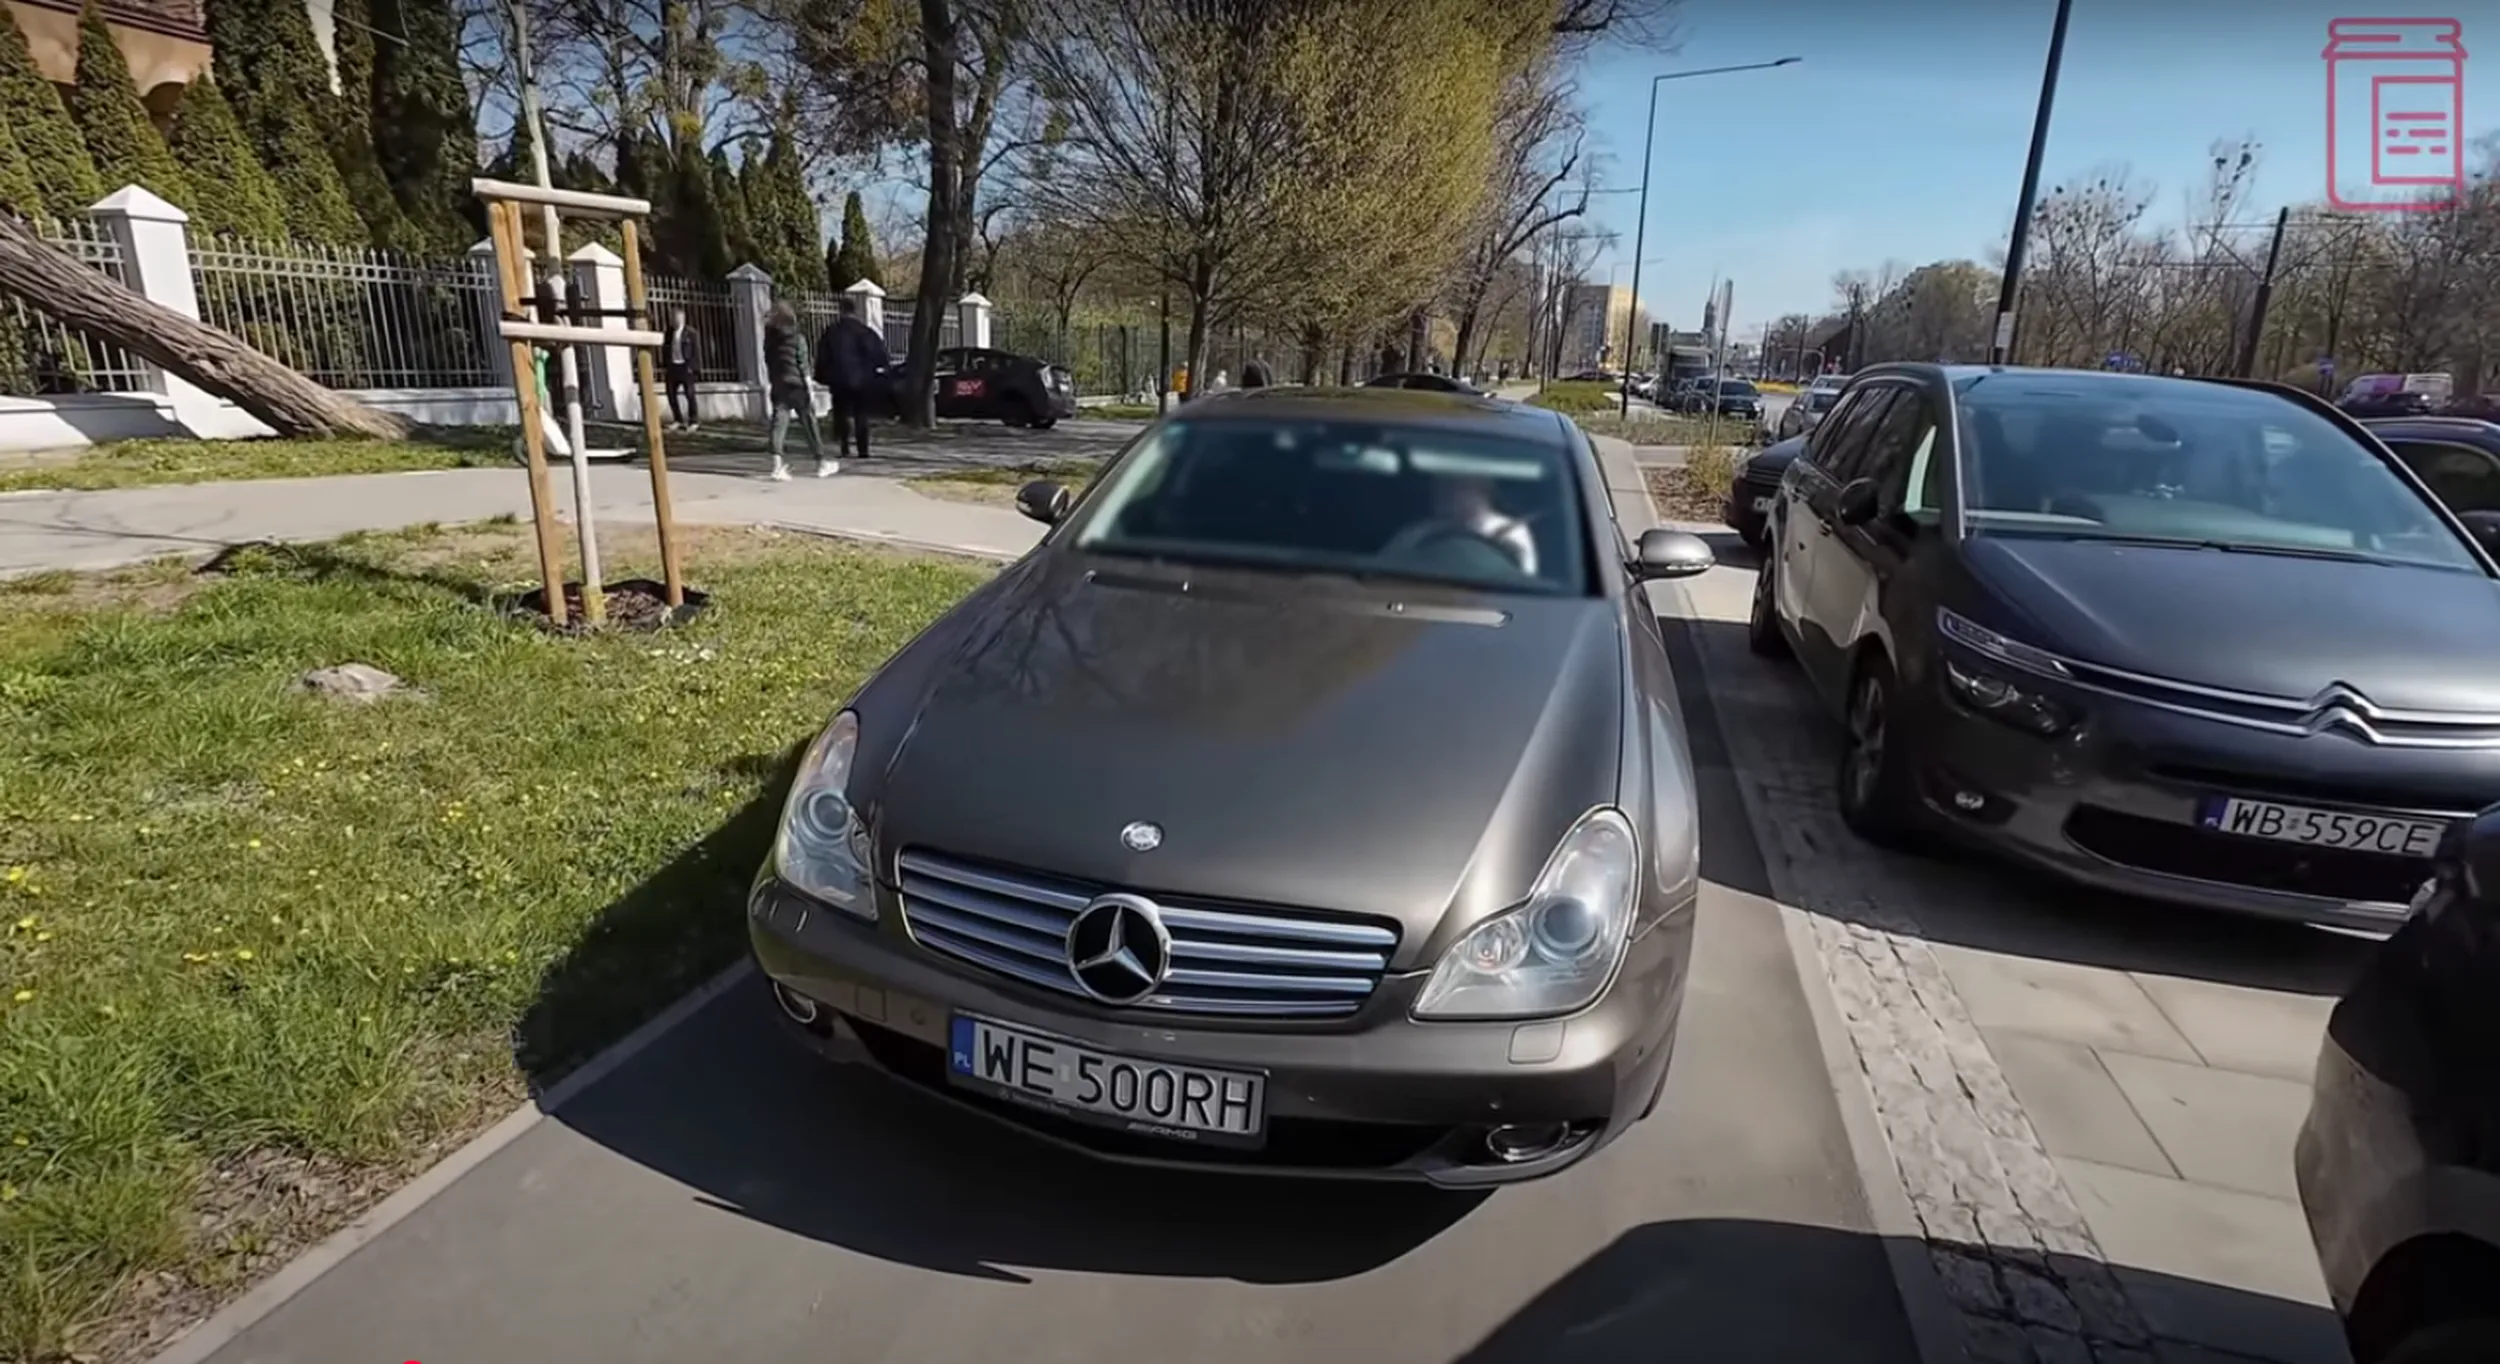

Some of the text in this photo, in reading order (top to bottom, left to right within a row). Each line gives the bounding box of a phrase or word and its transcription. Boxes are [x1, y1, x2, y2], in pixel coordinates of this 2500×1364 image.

[2231, 802, 2435, 855] WB 559CE
[953, 1051, 971, 1068] PL
[983, 1030, 1255, 1131] WE 500RH
[1149, 1126, 1198, 1140] AMG
